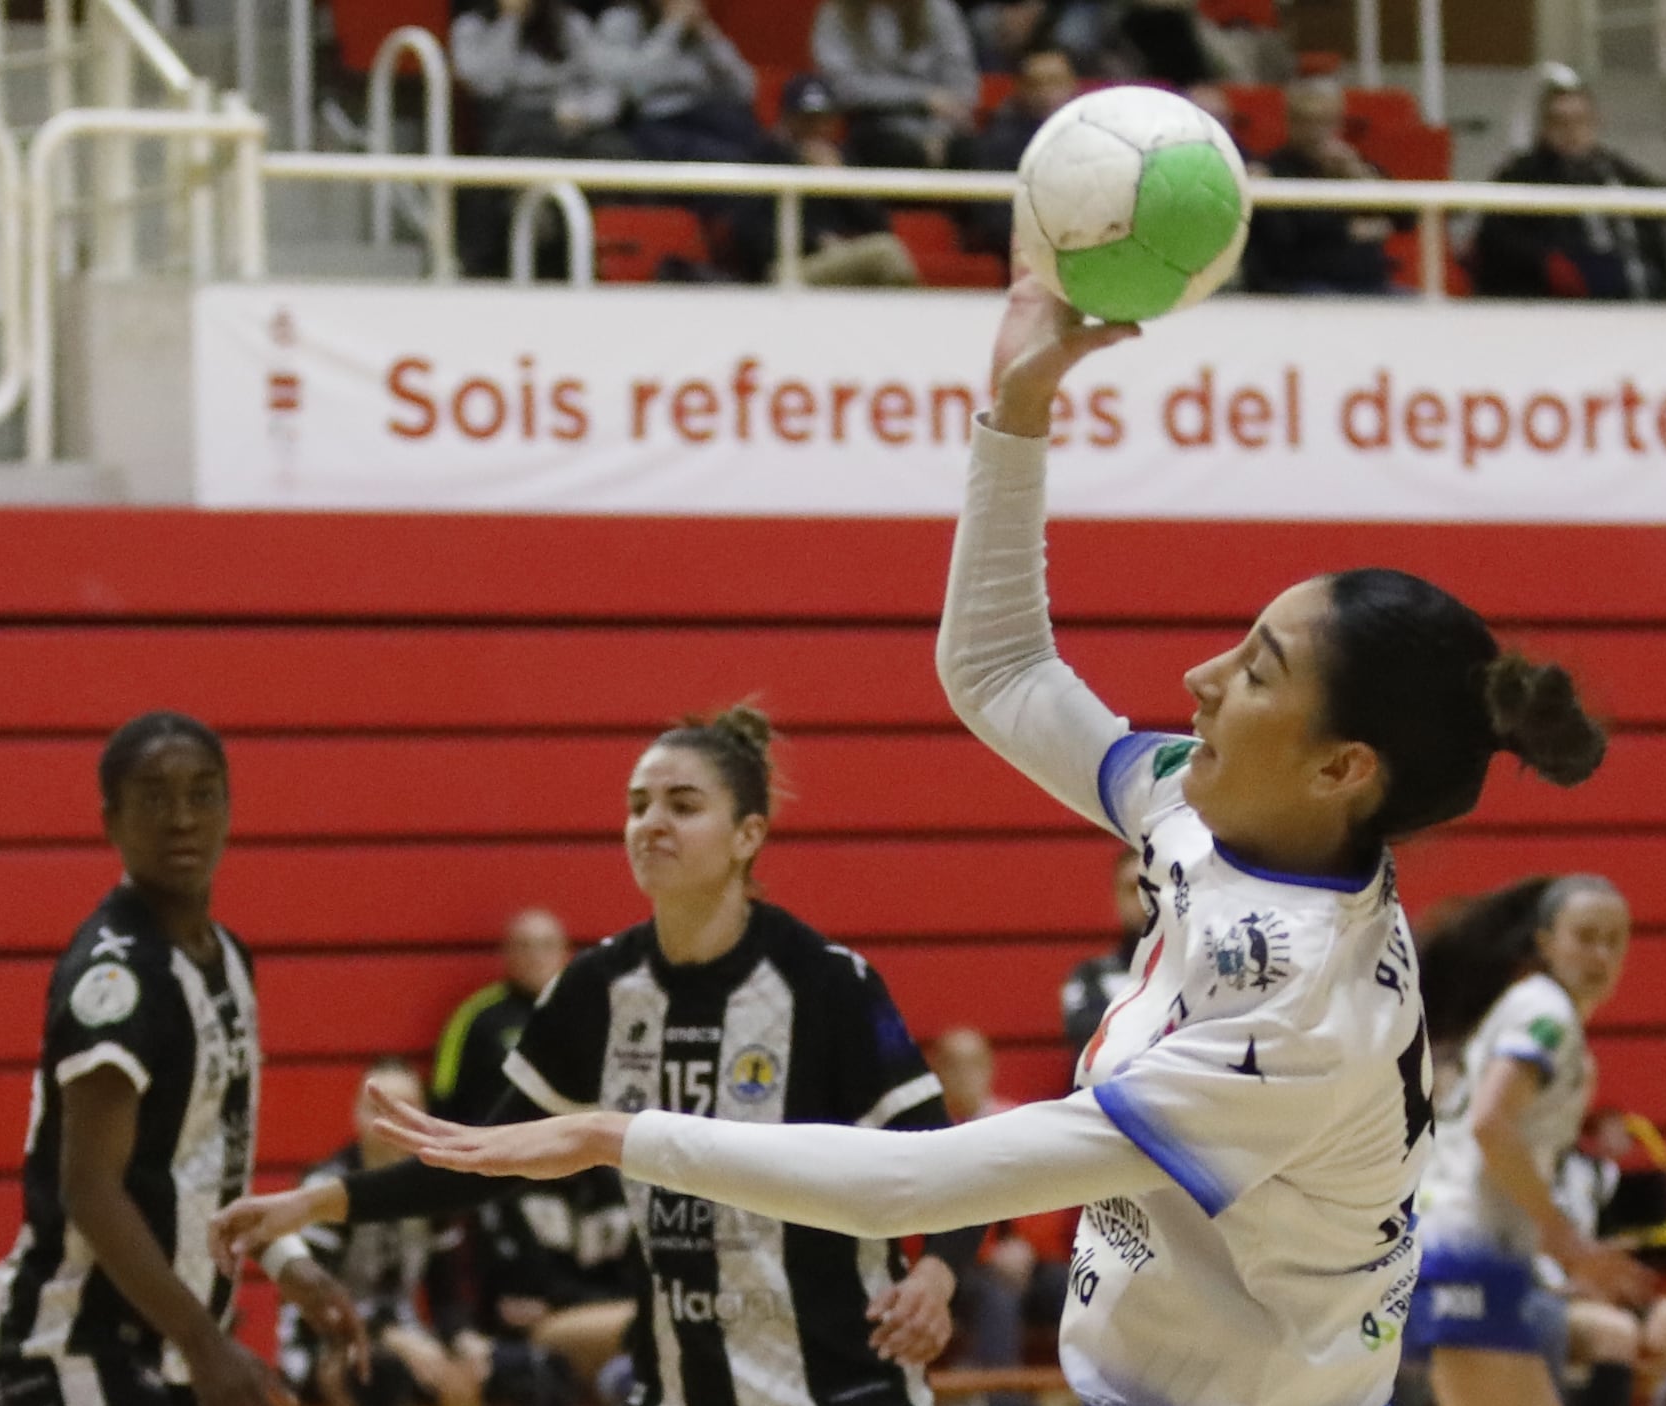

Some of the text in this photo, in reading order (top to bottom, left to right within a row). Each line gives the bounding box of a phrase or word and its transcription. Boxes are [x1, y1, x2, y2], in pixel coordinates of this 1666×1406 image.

[385, 355, 590, 444] Sois
[628, 356, 1127, 450] referenes
[1163, 366, 1301, 450] del
[664, 1061, 721, 1116] 15
